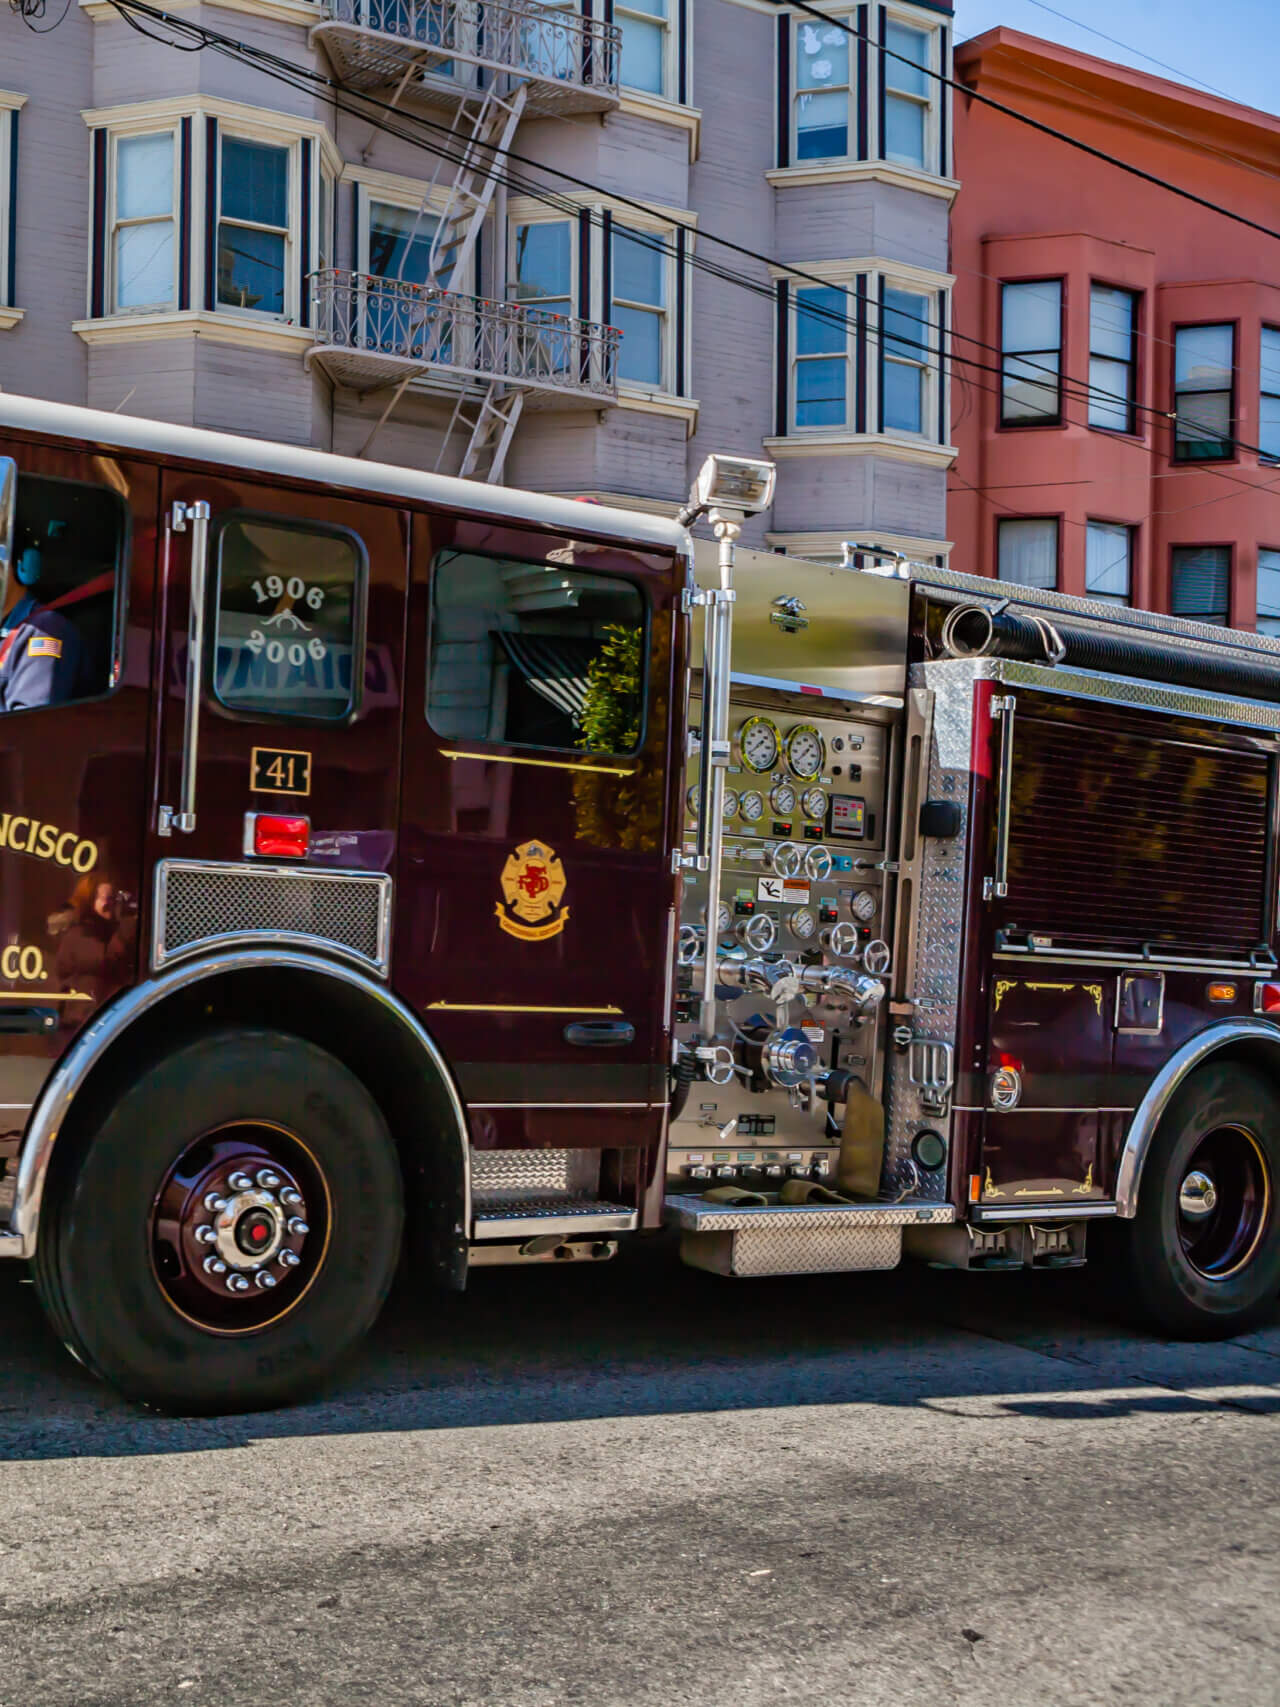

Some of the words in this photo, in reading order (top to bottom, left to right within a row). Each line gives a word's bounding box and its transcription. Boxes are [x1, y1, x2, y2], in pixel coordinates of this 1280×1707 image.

[251, 575, 325, 610] 1906
[244, 629, 327, 667] 2006
[265, 755, 295, 788] 41
[0, 945, 49, 980] CO.
